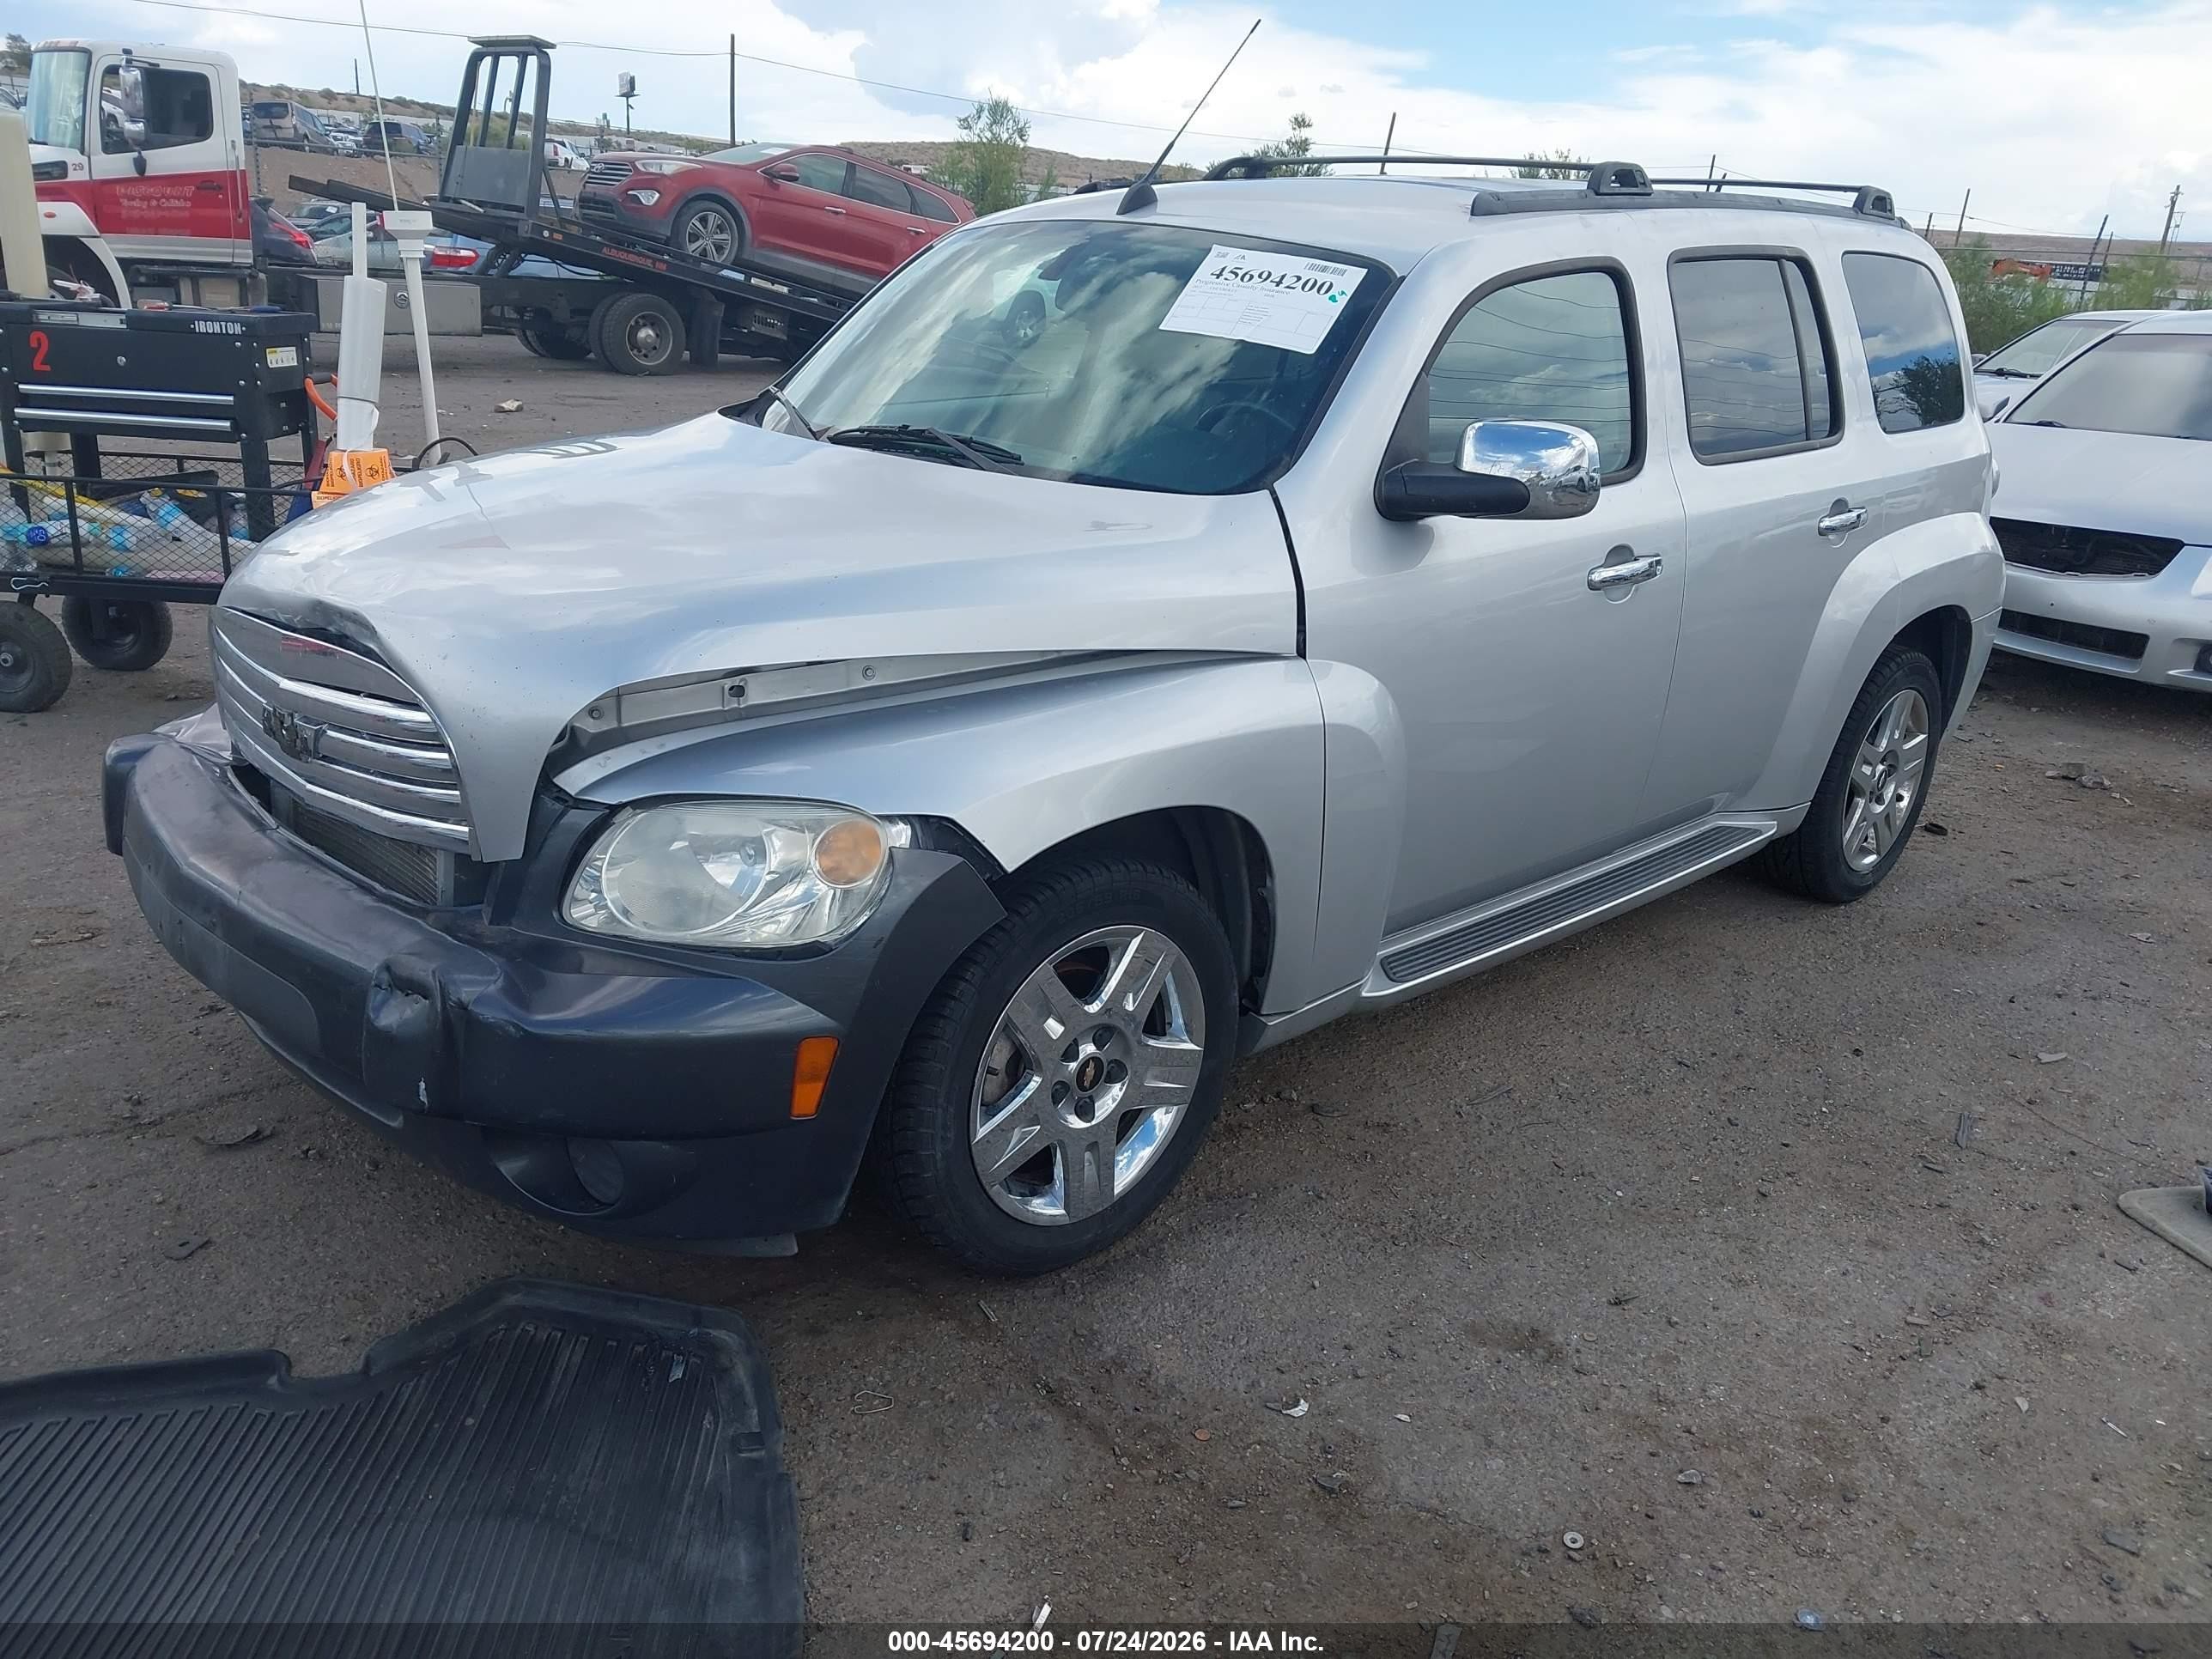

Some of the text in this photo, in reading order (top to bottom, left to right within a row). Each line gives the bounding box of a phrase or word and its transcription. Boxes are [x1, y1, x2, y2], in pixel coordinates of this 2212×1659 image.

[1195, 278, 1231, 288] Progressive
[1231, 283, 1259, 291] Casualty
[1260, 287, 1291, 295] Insurance
[1210, 265, 1334, 296] 45694200
[194, 320, 242, 335] IRONTON
[29, 331, 51, 371] 2
